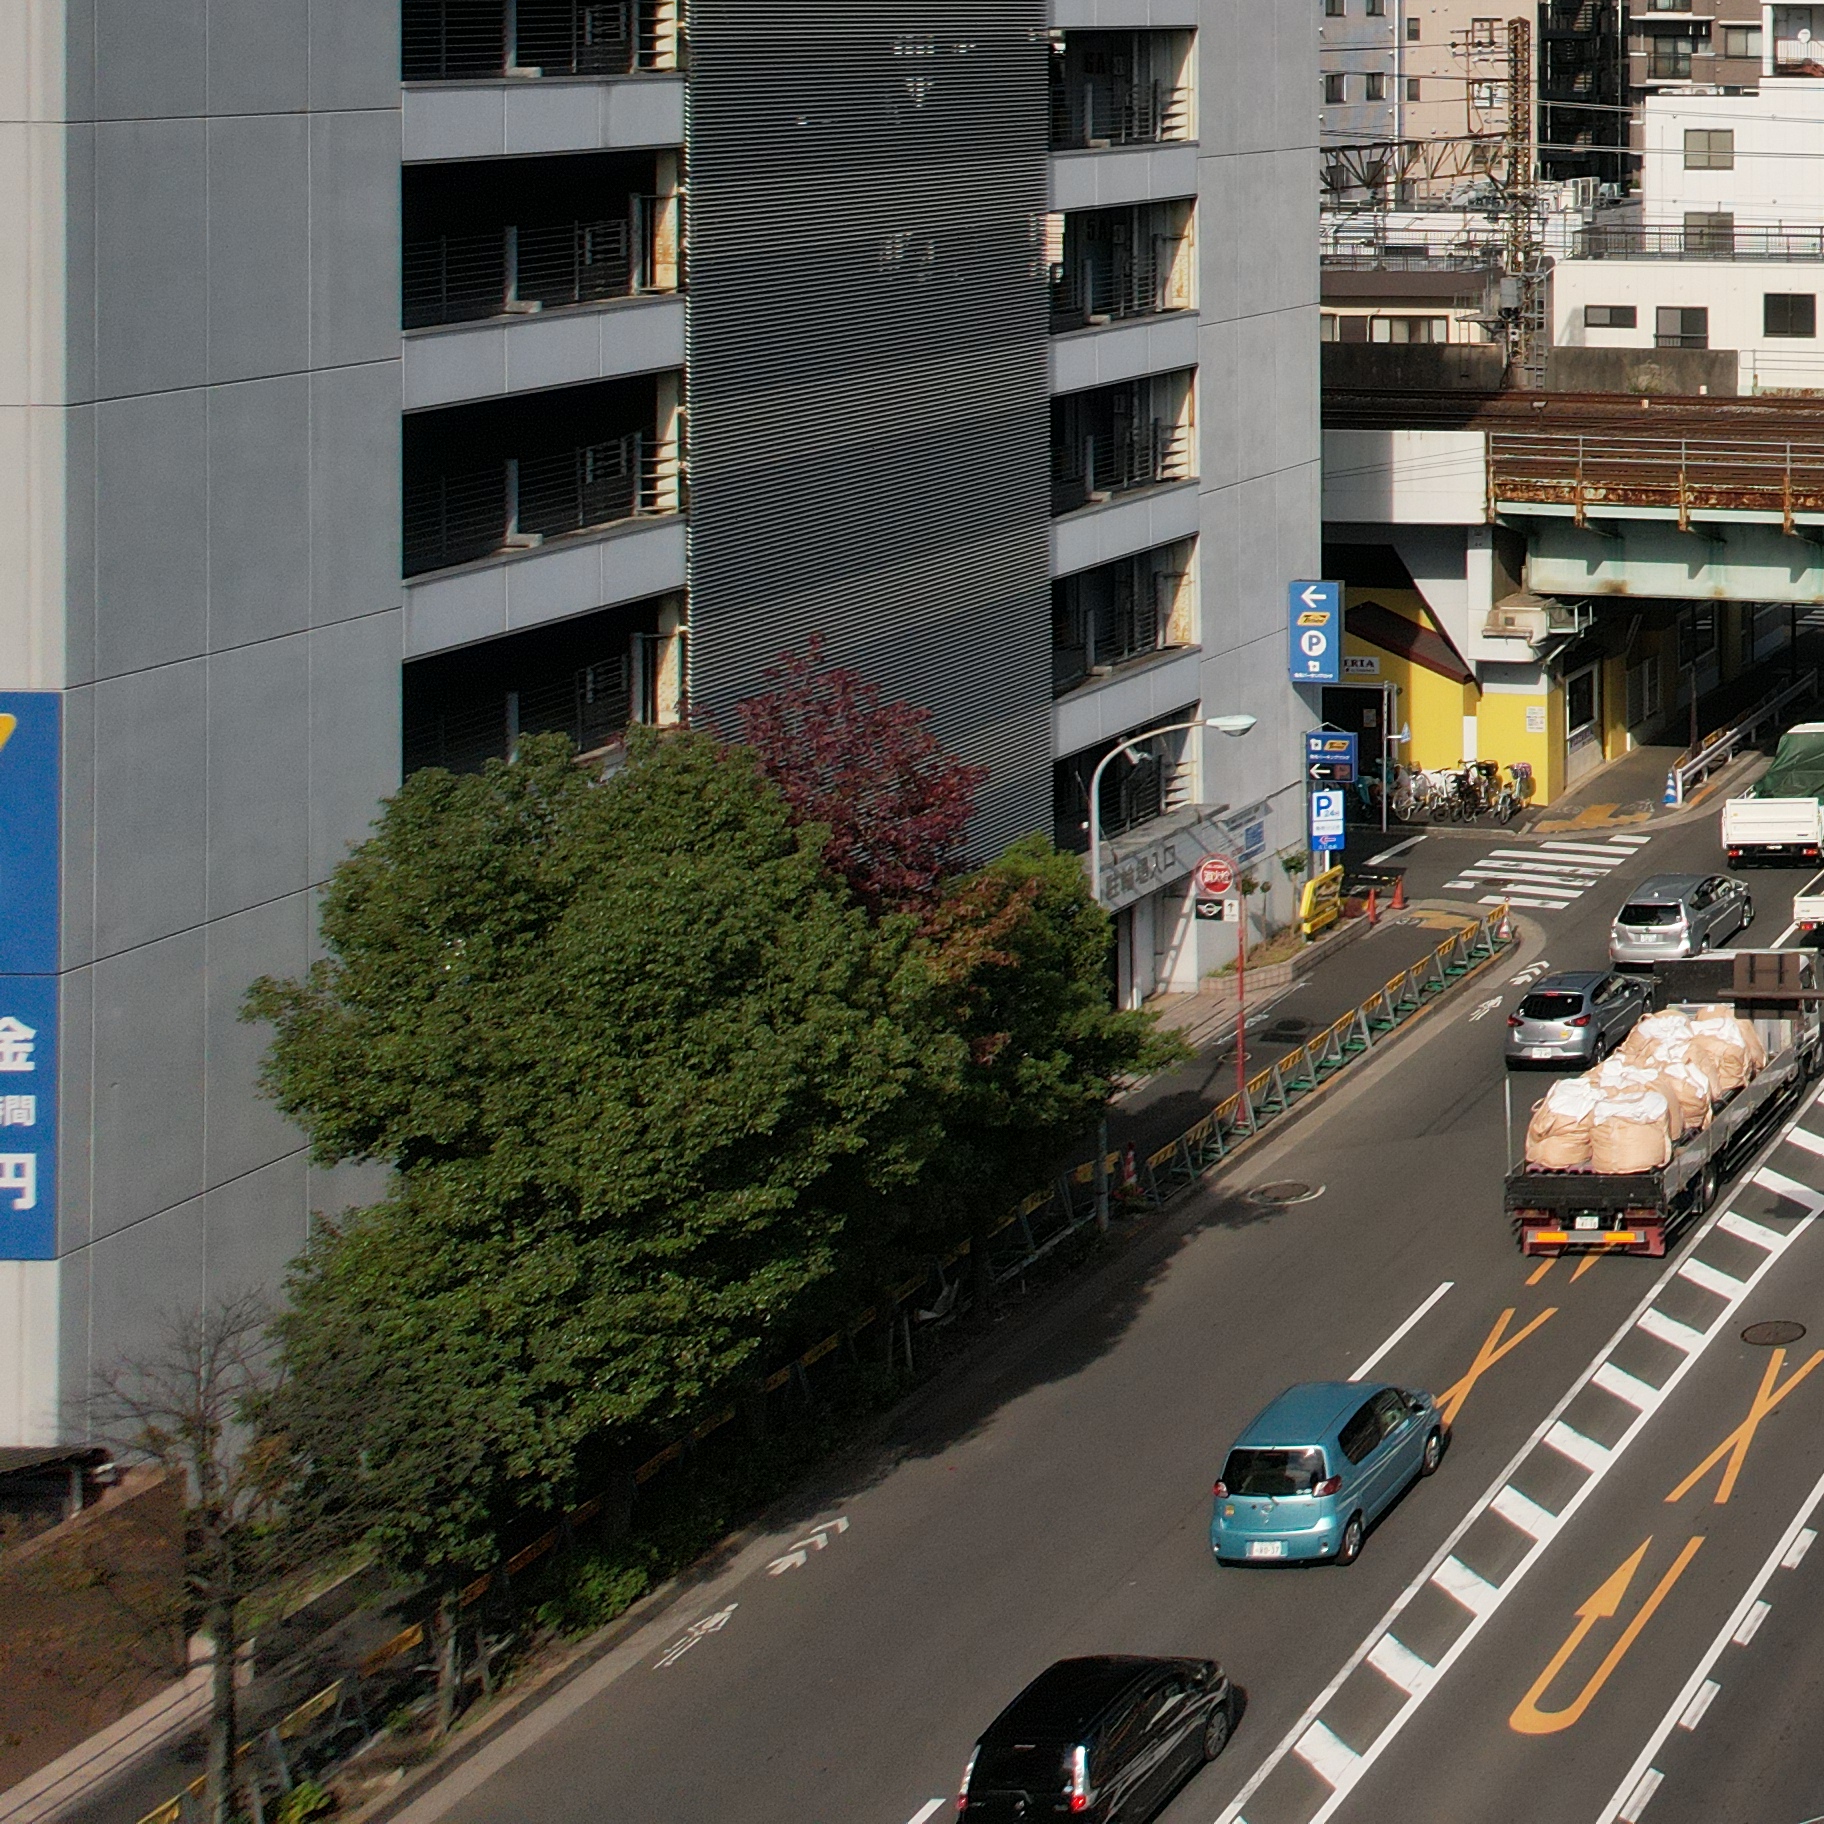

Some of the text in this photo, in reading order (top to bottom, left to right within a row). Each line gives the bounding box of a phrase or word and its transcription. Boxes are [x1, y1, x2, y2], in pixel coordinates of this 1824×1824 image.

[1308, 635, 1321, 653] P
[1316, 796, 1333, 817] P
[0, 1094, 37, 1127] 間
